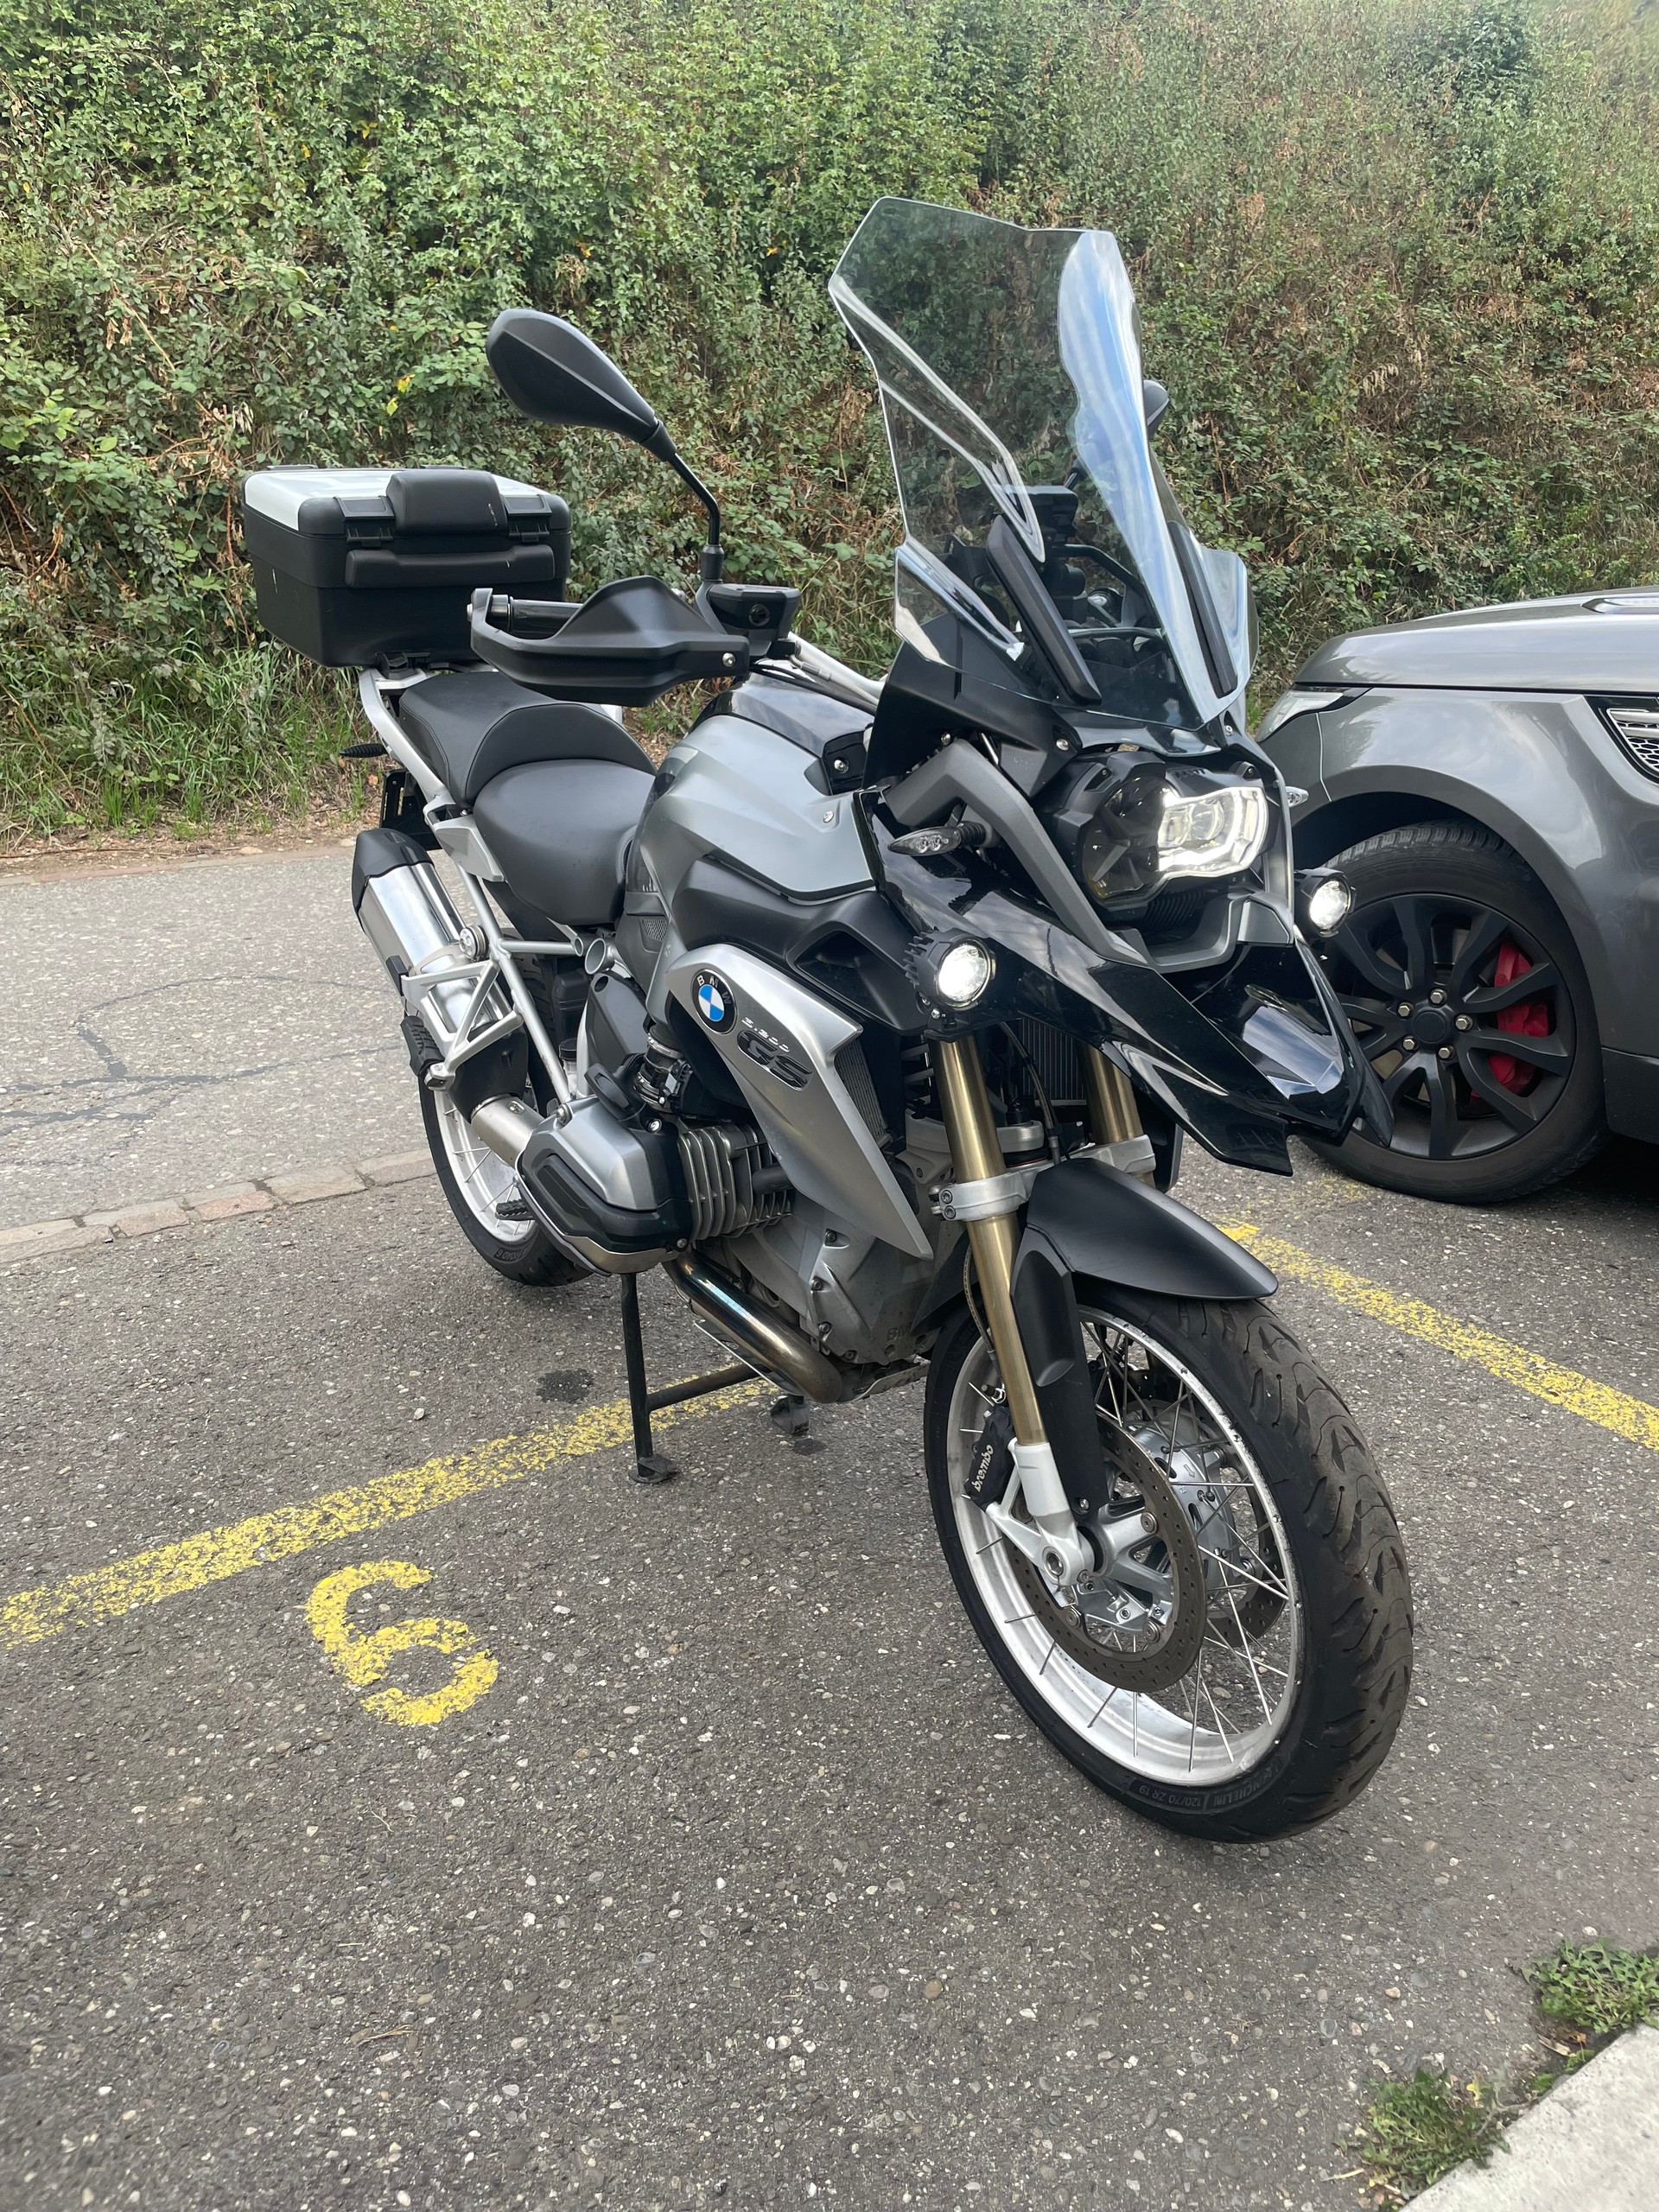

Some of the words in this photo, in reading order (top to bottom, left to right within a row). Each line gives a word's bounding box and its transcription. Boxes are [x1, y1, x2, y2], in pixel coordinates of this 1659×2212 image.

[696, 975, 733, 1004] BMW
[737, 1029, 813, 1091] GS
[971, 1444, 994, 1492] brembo
[305, 1559, 499, 1726] 6
[1139, 1784, 1151, 1795] 19
[1152, 1788, 1168, 1802] ZR
[1168, 1794, 1202, 1807] 120/70
